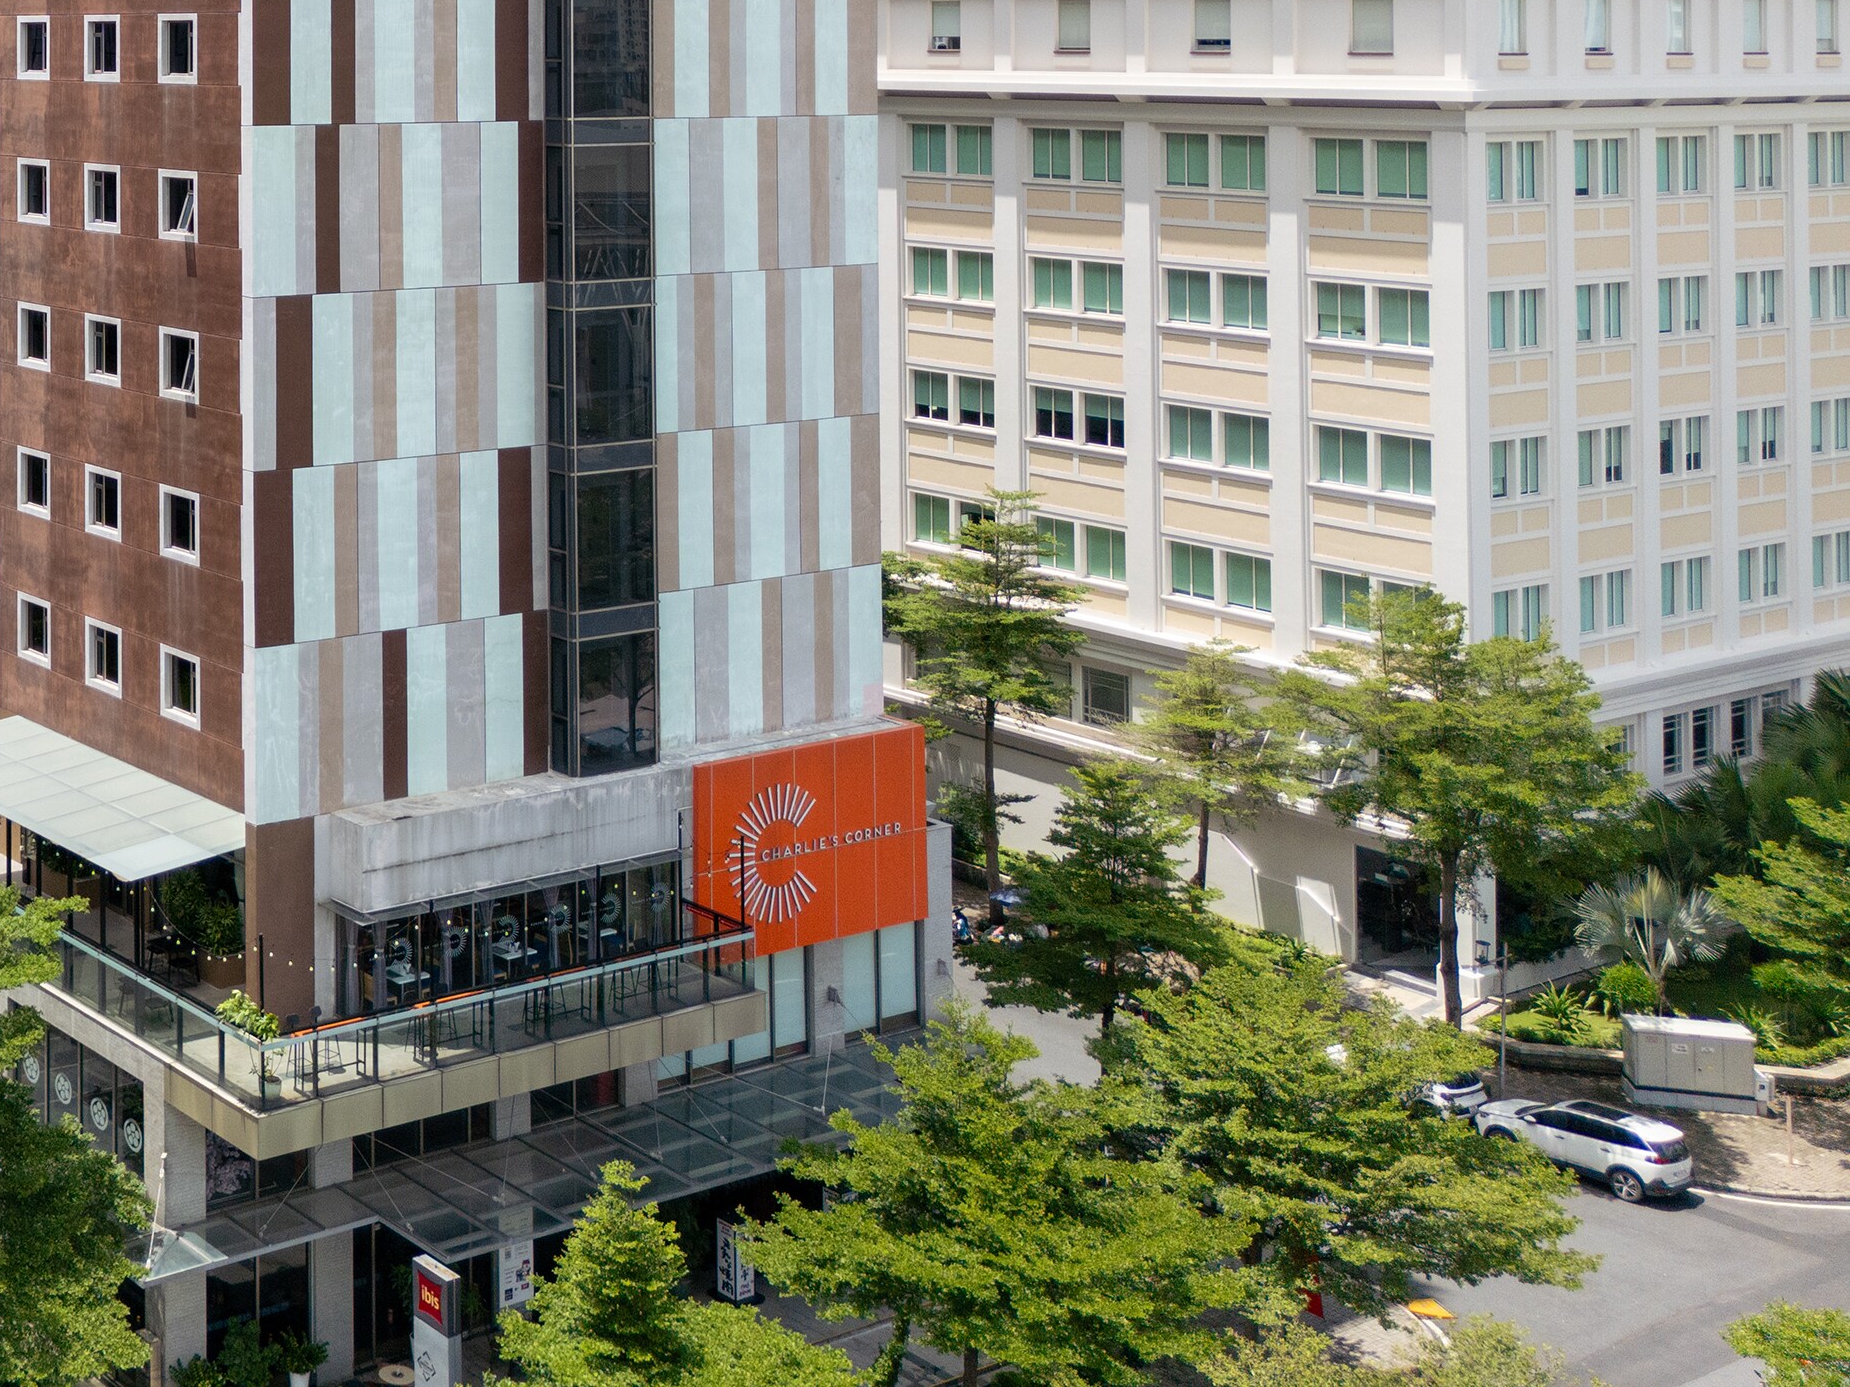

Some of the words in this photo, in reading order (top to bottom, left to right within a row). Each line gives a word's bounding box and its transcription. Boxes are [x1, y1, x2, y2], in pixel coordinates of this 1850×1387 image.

[761, 835, 839, 861] CHARLIE'S
[844, 822, 901, 844] CORNER
[421, 1284, 440, 1310] ibis
